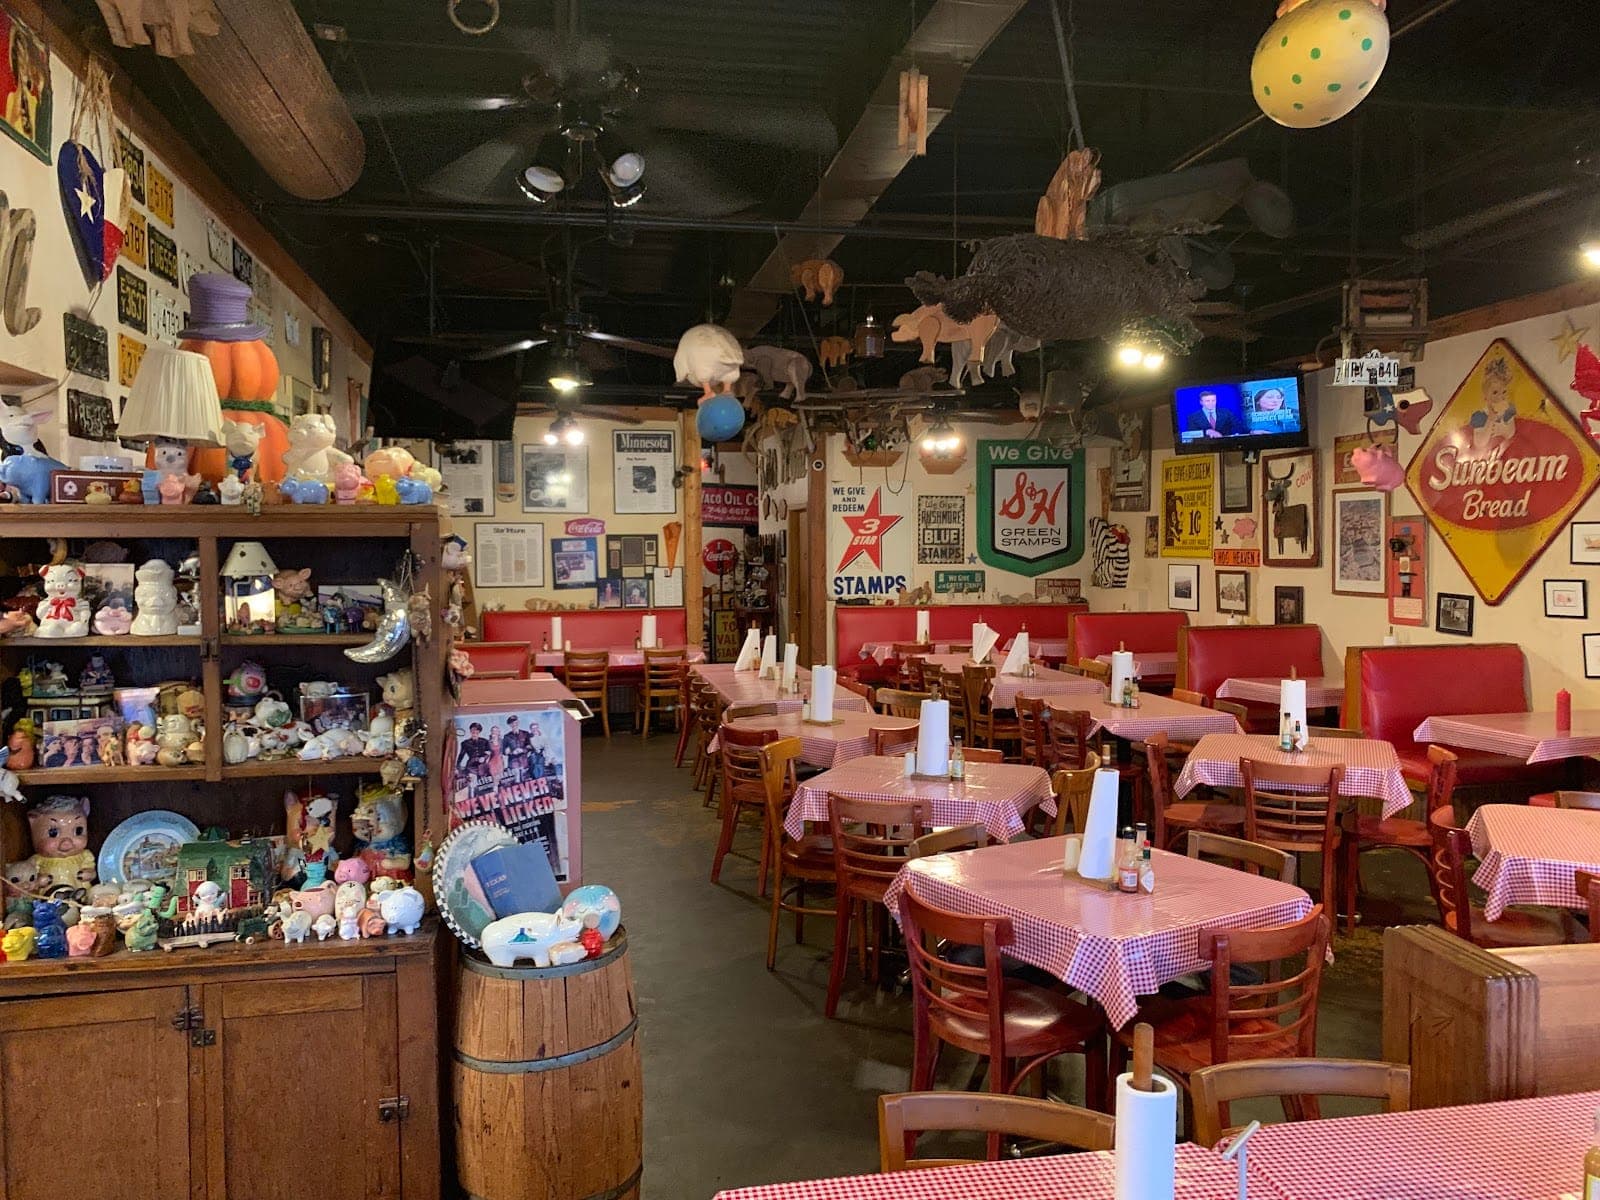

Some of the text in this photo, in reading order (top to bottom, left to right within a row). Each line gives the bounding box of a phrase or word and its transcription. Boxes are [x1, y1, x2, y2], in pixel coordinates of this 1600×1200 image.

[620, 433, 668, 449] Minnesota
[989, 446, 1074, 460] We Give
[1428, 446, 1569, 491] Sunbeam
[832, 487, 865, 495] WE GIVE
[998, 471, 1065, 526] S&H
[832, 504, 865, 512] REDEEM
[1462, 489, 1531, 520] Bread
[858, 518, 880, 535] 3
[1001, 528, 1061, 537] GREEN
[852, 535, 877, 545] STAR
[924, 529, 959, 545] BLUE
[1001, 538, 1062, 546] STAMPS
[921, 547, 961, 559] STAMPS
[833, 575, 906, 595] STAMPS
[501, 777, 550, 805] NEVER
[502, 796, 554, 826] LICKED
